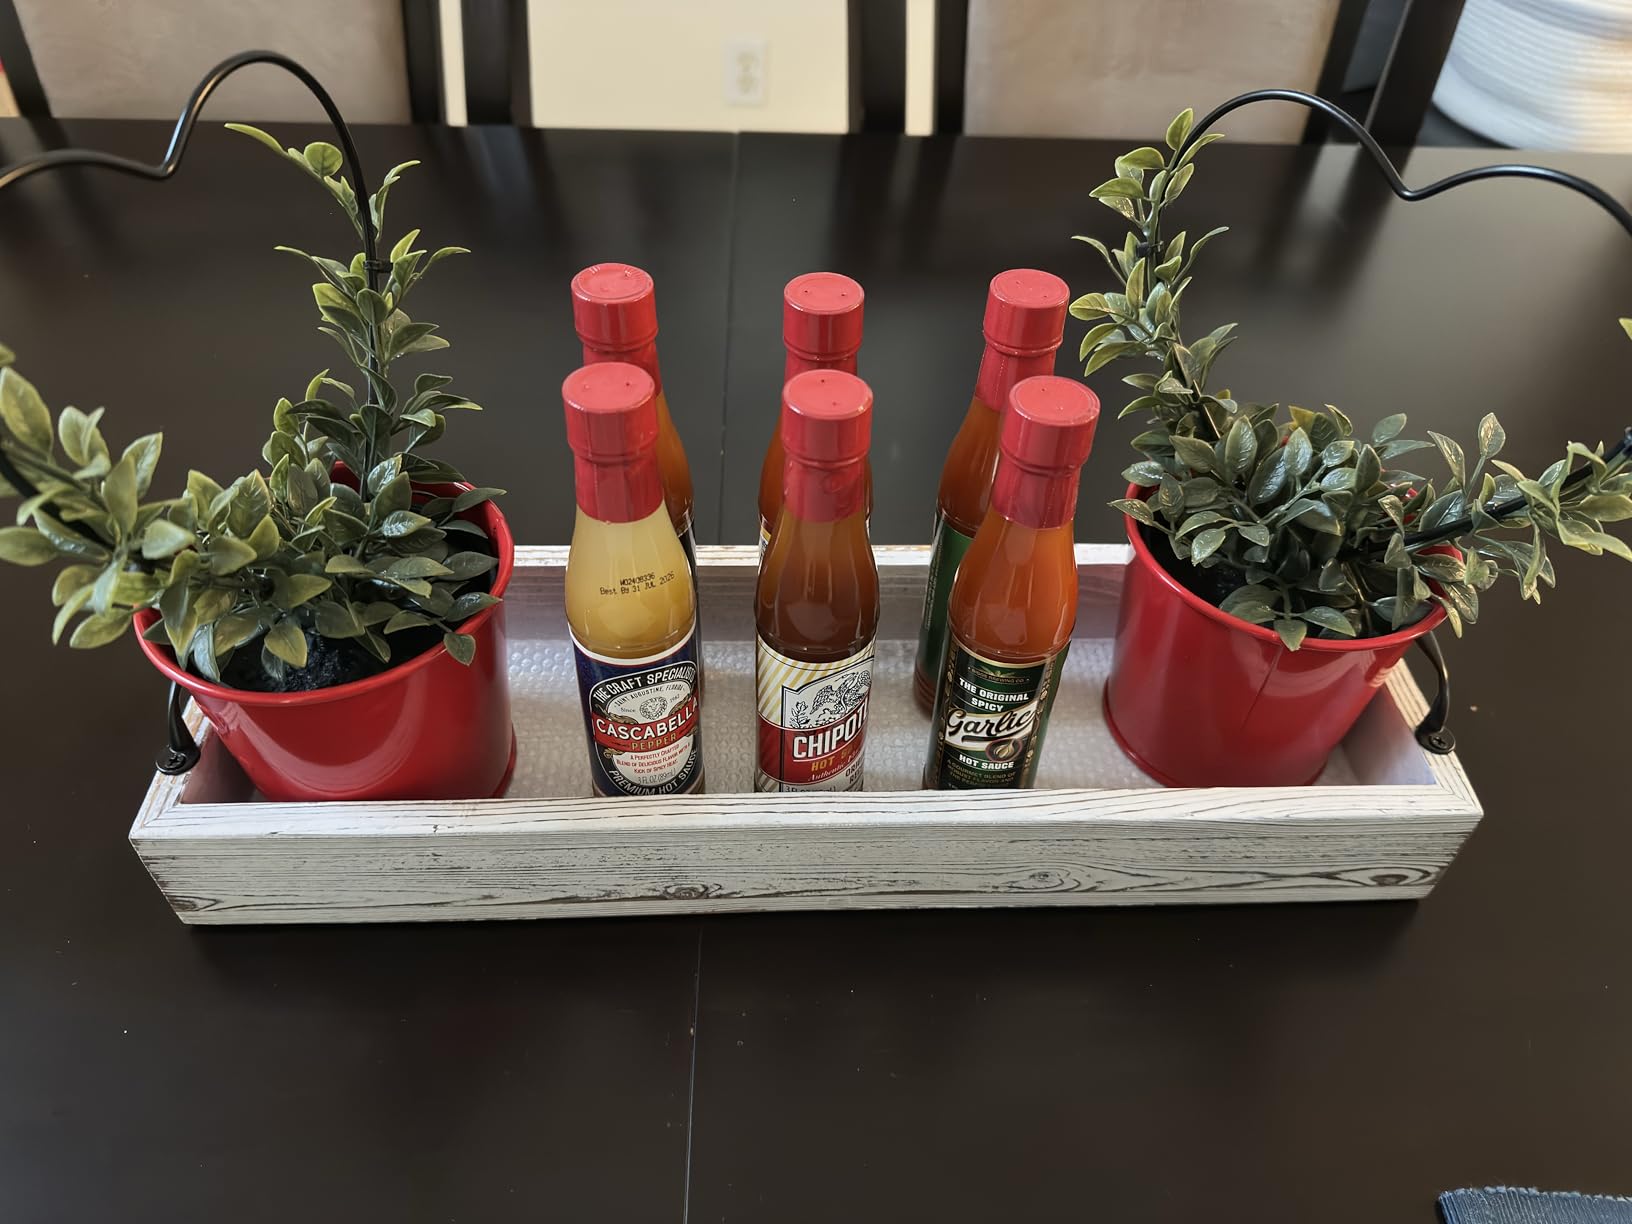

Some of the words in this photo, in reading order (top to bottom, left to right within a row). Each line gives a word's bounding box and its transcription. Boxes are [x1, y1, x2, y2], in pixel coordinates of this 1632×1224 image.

[593, 687, 611, 704] THE
[606, 677, 642, 699] CRAFT
[959, 678, 976, 693] THE
[980, 689, 1029, 701] ORIGINAL
[972, 697, 1003, 712] SPICY
[947, 708, 1034, 738] Garlic
[632, 733, 676, 750] PEPPER
[653, 764, 666, 772] SPICY
[811, 756, 835, 771] HOT
[959, 754, 979, 767] HOT
[981, 761, 1015, 770] SAUCE
[609, 770, 656, 795] PREMIUM
[659, 781, 678, 794] HOT
[678, 748, 697, 780] SAUCE
